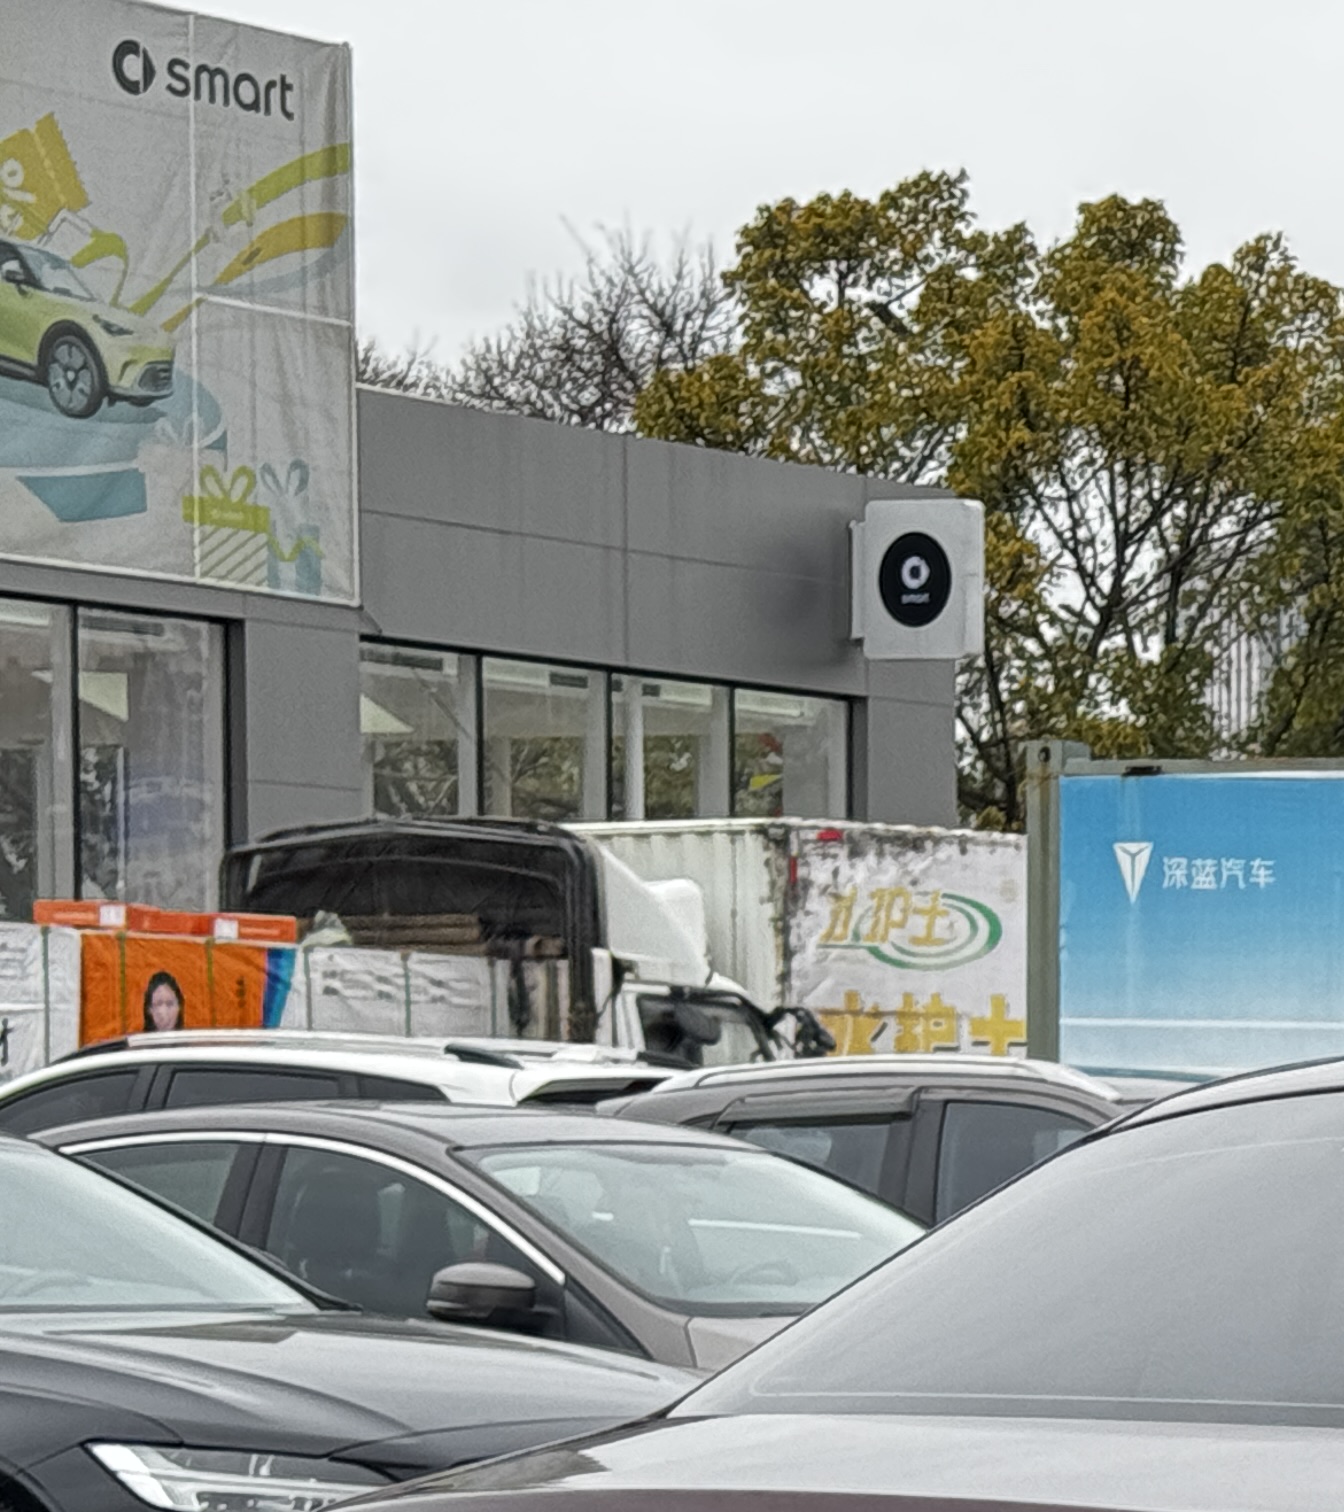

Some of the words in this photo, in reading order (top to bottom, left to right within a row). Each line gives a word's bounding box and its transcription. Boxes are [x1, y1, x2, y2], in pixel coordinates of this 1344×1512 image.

[165, 57, 295, 121] smart
[1161, 856, 1277, 890] 深蓝汽车
